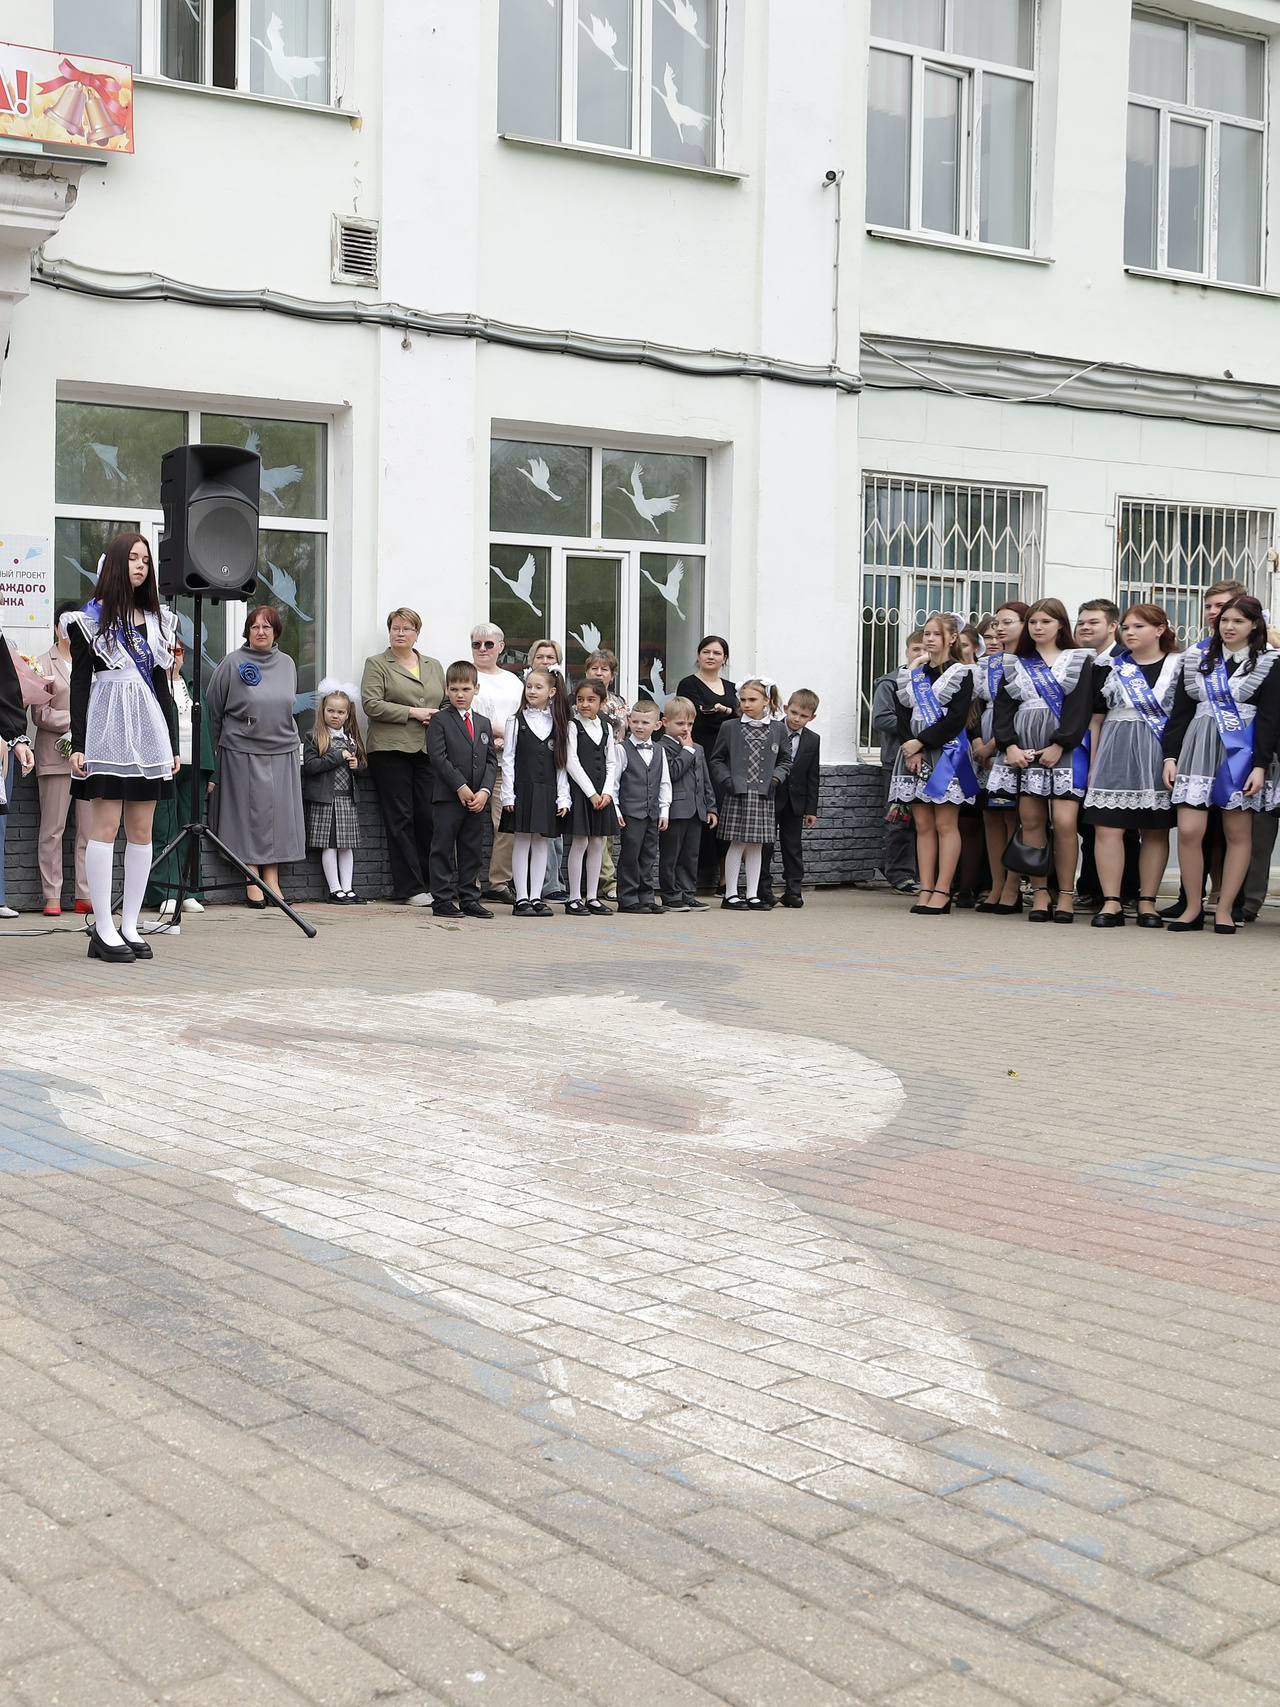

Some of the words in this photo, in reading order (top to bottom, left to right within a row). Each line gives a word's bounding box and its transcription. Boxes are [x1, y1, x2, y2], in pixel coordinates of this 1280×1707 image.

[16, 571, 46, 579] ПРОЕКТ
[3, 597, 24, 606] НКА
[1220, 709, 1242, 732] 2025
